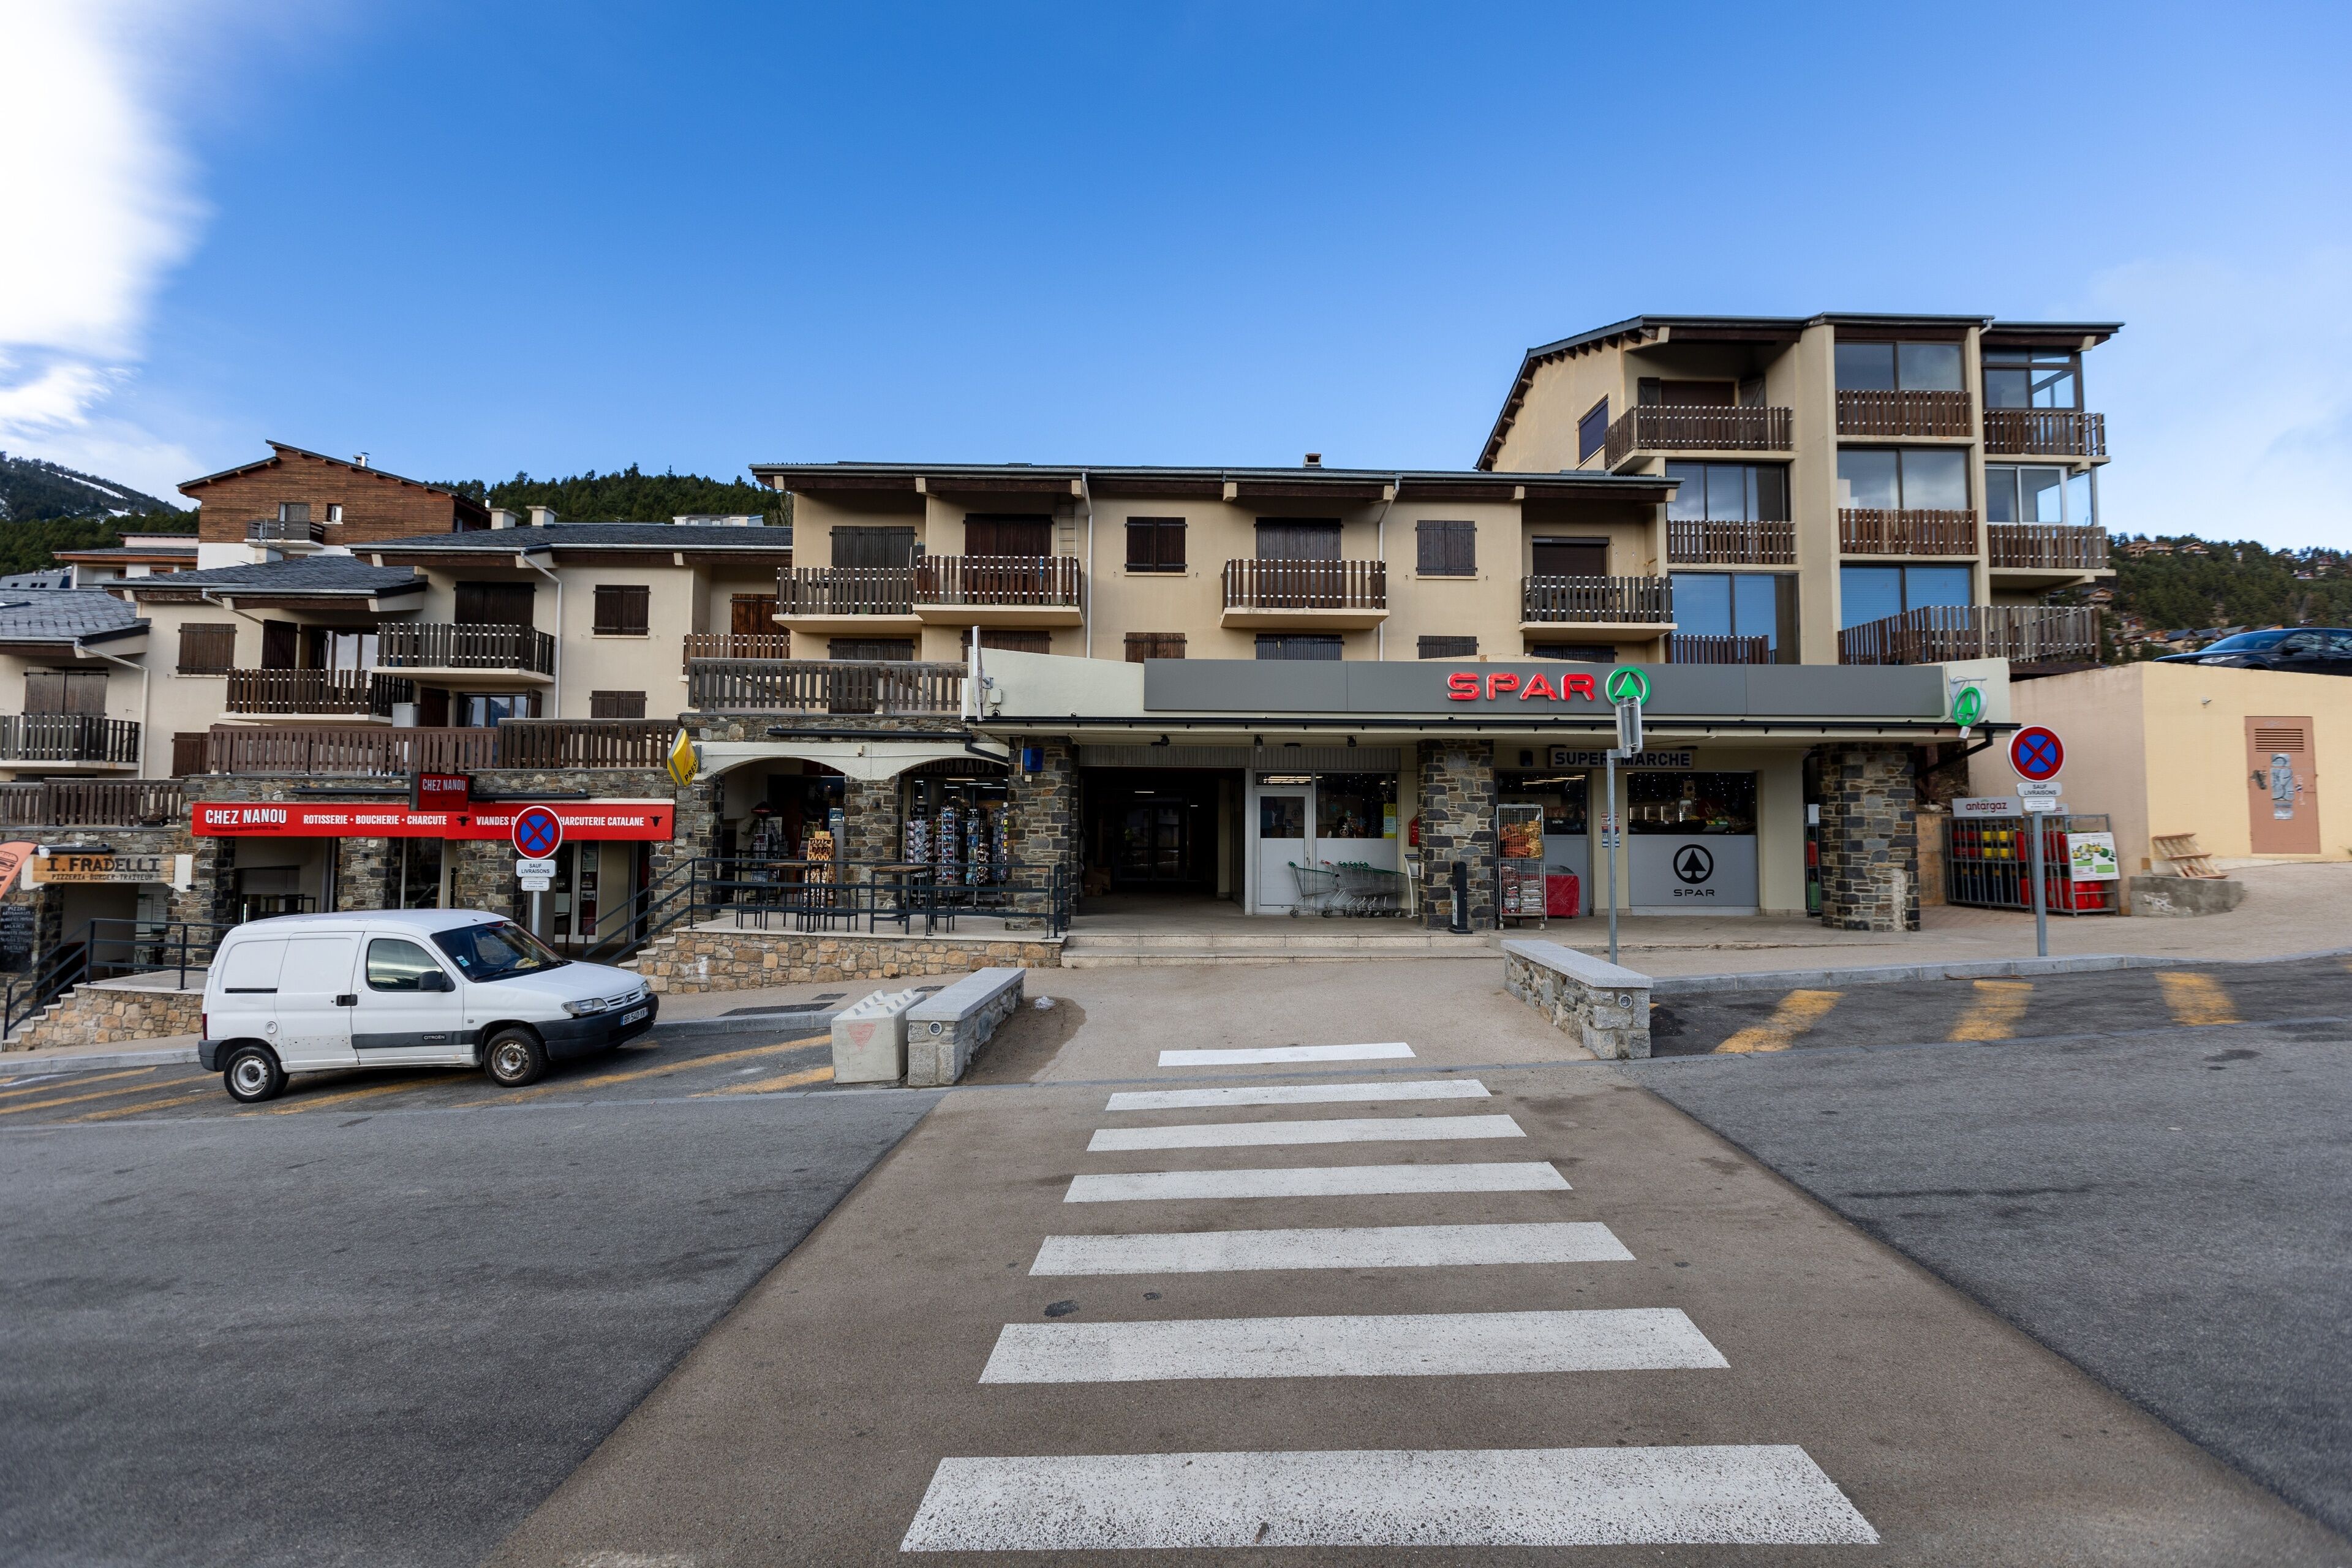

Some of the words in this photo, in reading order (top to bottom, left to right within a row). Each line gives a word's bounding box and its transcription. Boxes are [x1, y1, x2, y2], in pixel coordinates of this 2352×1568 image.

[1447, 673, 1596, 701] SPAR
[1555, 752, 1607, 766] SUPER
[1621, 752, 1690, 766] MARCHE
[422, 778, 441, 791] CHEZ
[443, 778, 466, 791] NANOU
[1966, 801, 2007, 813] antargaz
[205, 809, 239, 824] CHEZ
[243, 809, 287, 824] NANOU
[303, 815, 348, 824] ROTISSERIE
[356, 815, 399, 824] BOUCHERIE
[476, 816, 509, 826] VIANDES
[560, 816, 605, 826] HARCUTERIE
[607, 816, 644, 826] CATALANE
